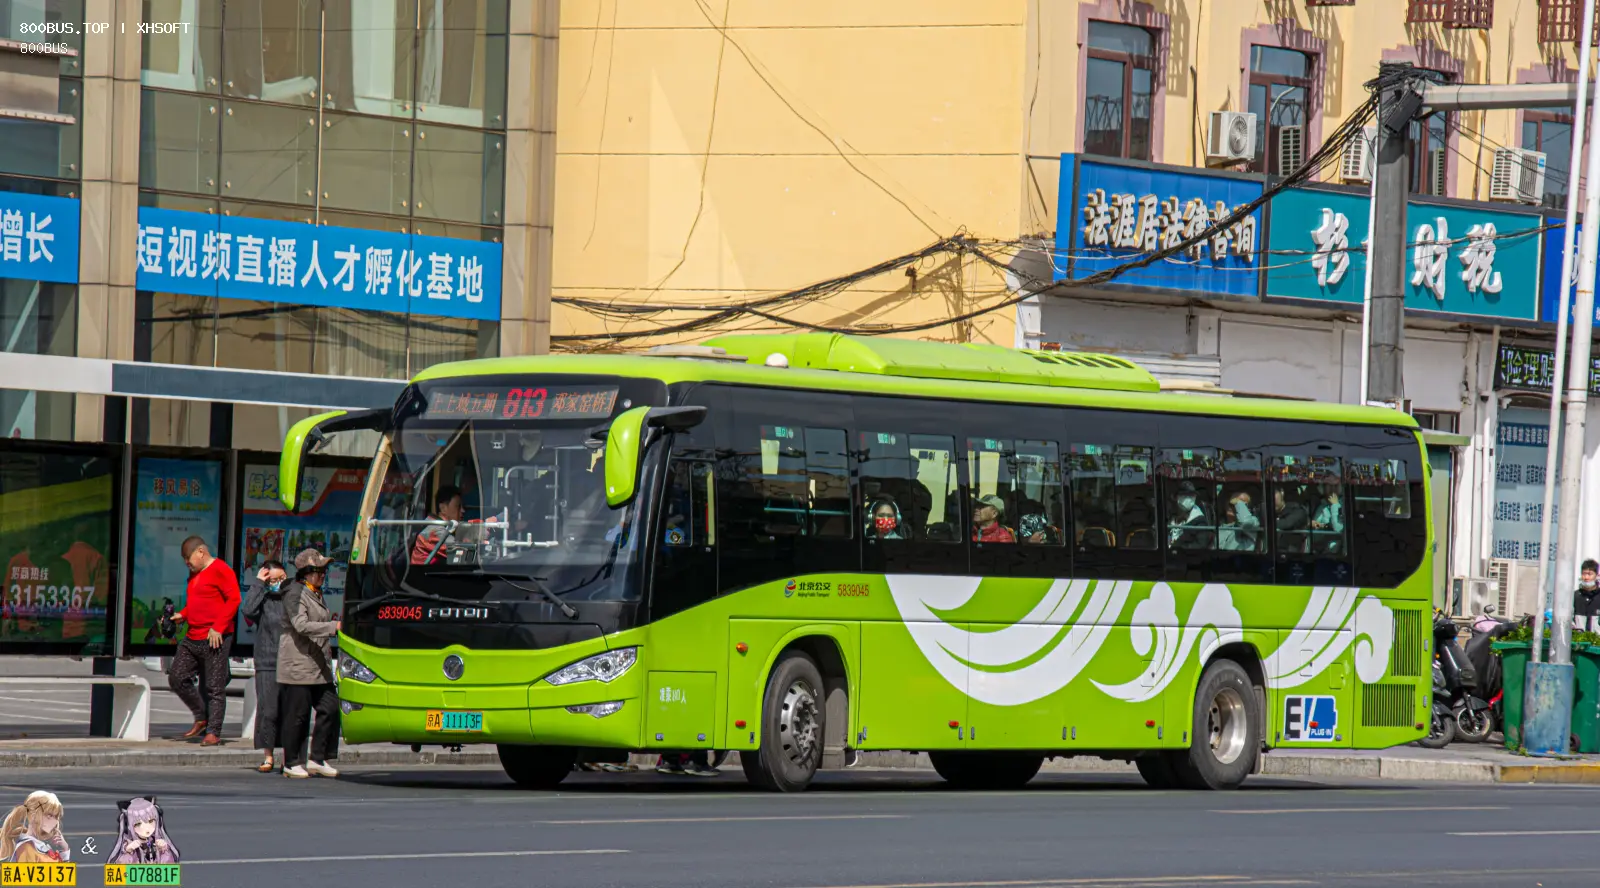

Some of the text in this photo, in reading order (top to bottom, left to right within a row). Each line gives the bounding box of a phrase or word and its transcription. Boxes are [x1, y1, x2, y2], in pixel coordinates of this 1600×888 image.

[0, 208, 55, 263] 增长
[136, 222, 485, 304] 短视频直播人才孵化基地
[1311, 207, 1503, 300] 杉财税
[503, 387, 548, 418] 813
[10, 583, 96, 611] 3153367
[798, 581, 831, 591] 北京公交
[838, 583, 870, 597] 5839045
[377, 605, 423, 620] 5839045
